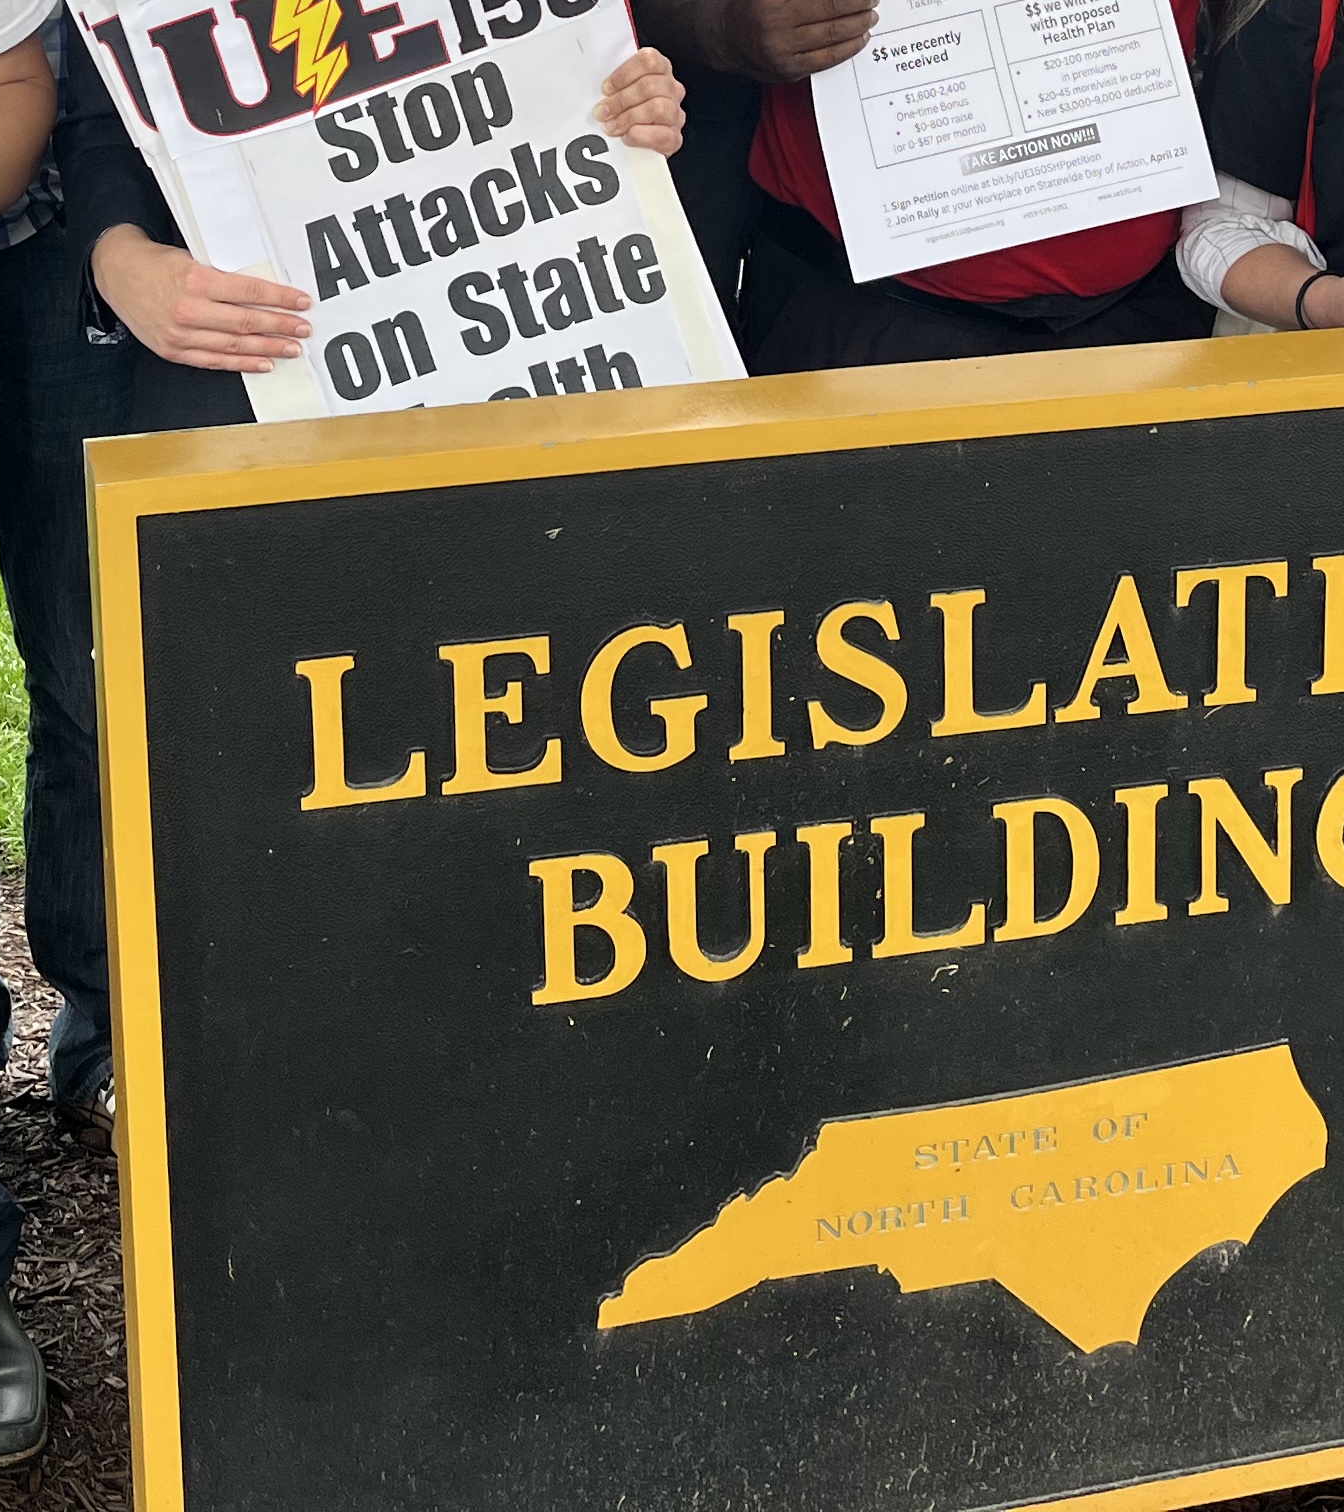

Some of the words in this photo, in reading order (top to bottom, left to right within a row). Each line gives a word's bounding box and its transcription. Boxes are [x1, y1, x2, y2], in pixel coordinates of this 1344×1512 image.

[1025, 1, 1041, 17] $$
[1043, 0, 1061, 12] we
[1029, 15, 1057, 31] with
[1060, 0, 1119, 28] proposed
[872, 45, 888, 62] $$
[890, 45, 908, 57] we
[910, 30, 960, 52] recently
[1042, 25, 1084, 44] Health
[1084, 20, 1115, 34] Plan
[895, 48, 948, 72] received
[314, 61, 514, 183] Stop
[961, 151, 997, 172] TAKE
[998, 138, 1048, 162] ACTION
[1050, 127, 1095, 149] NOW!!!
[304, 133, 620, 302] Attacks
[323, 309, 437, 402] on
[446, 232, 666, 357] State
[912, 1118, 1061, 1172] STATE
[1091, 1112, 1151, 1155] OF
[812, 1192, 974, 1245] NORTH
[1007, 1151, 1242, 1211] CAROLINA
